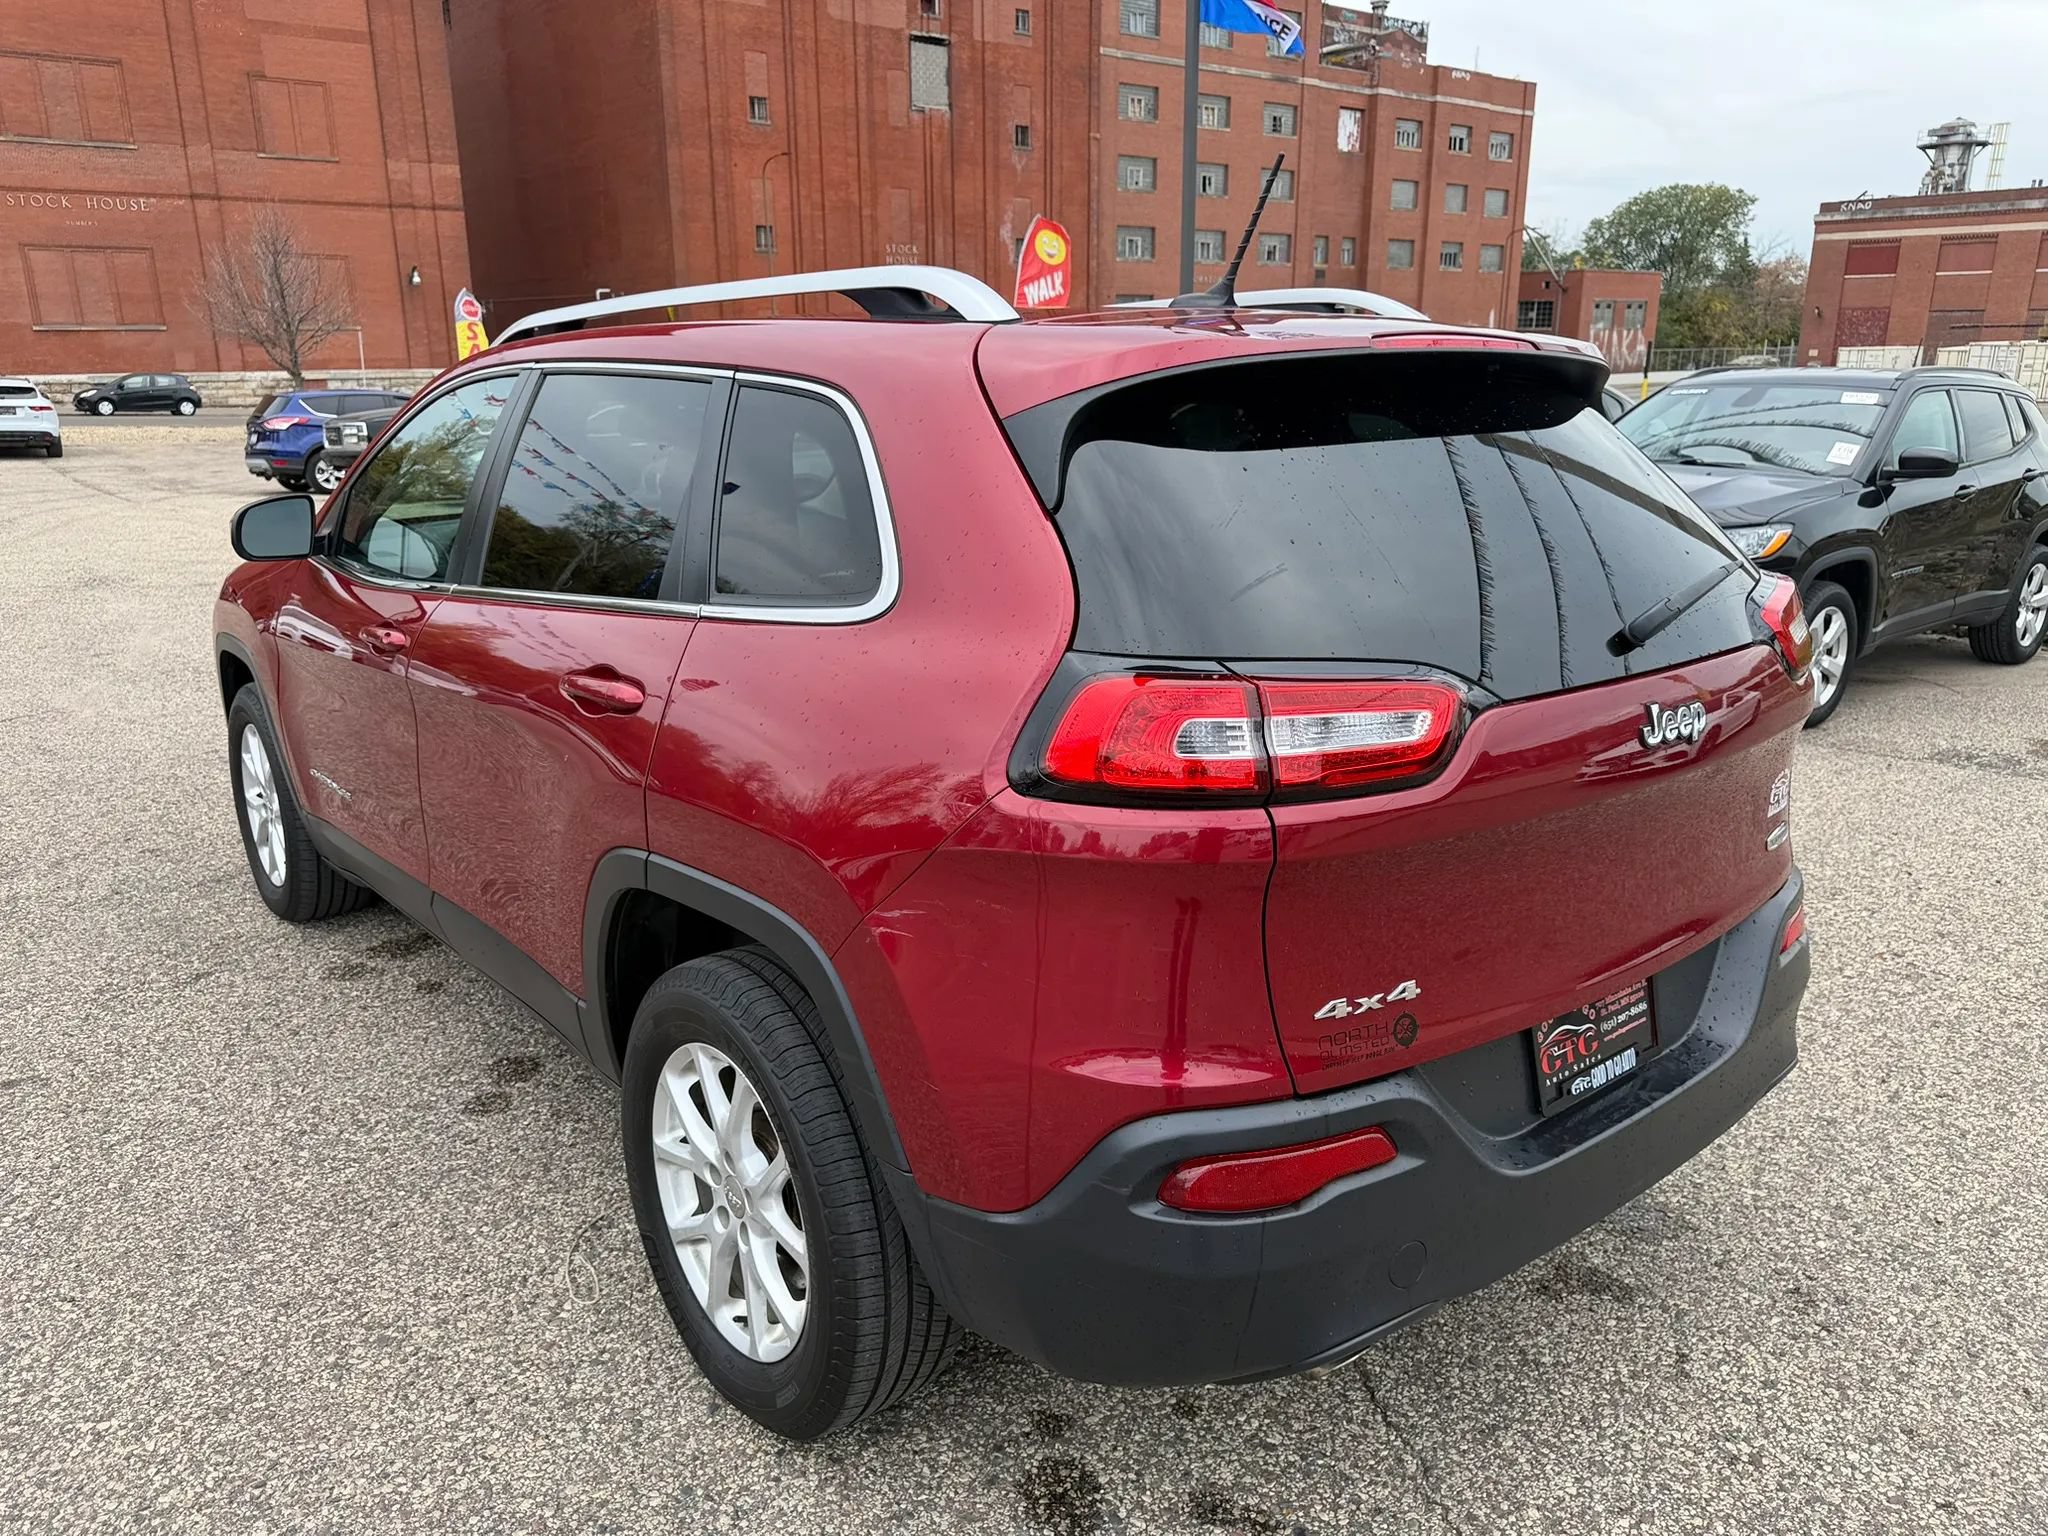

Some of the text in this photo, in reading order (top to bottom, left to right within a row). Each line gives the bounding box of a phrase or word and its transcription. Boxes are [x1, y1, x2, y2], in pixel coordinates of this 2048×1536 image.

[6, 194, 150, 211] STOCK HOUSE
[885, 244, 919, 255] STOCK
[1023, 271, 1065, 308] WALK
[1640, 701, 1707, 749] Jeep
[1314, 979, 1421, 1020] 4x4
[1617, 1001, 1648, 1023] 207-8686
[1319, 1021, 1389, 1050] NORTH
[1320, 1037, 1390, 1061] OLMSTED
[1545, 1055, 1602, 1087] Auto Sales
[1591, 1062, 1607, 1089] GOOD
[1621, 1047, 1637, 1072] AUTO
